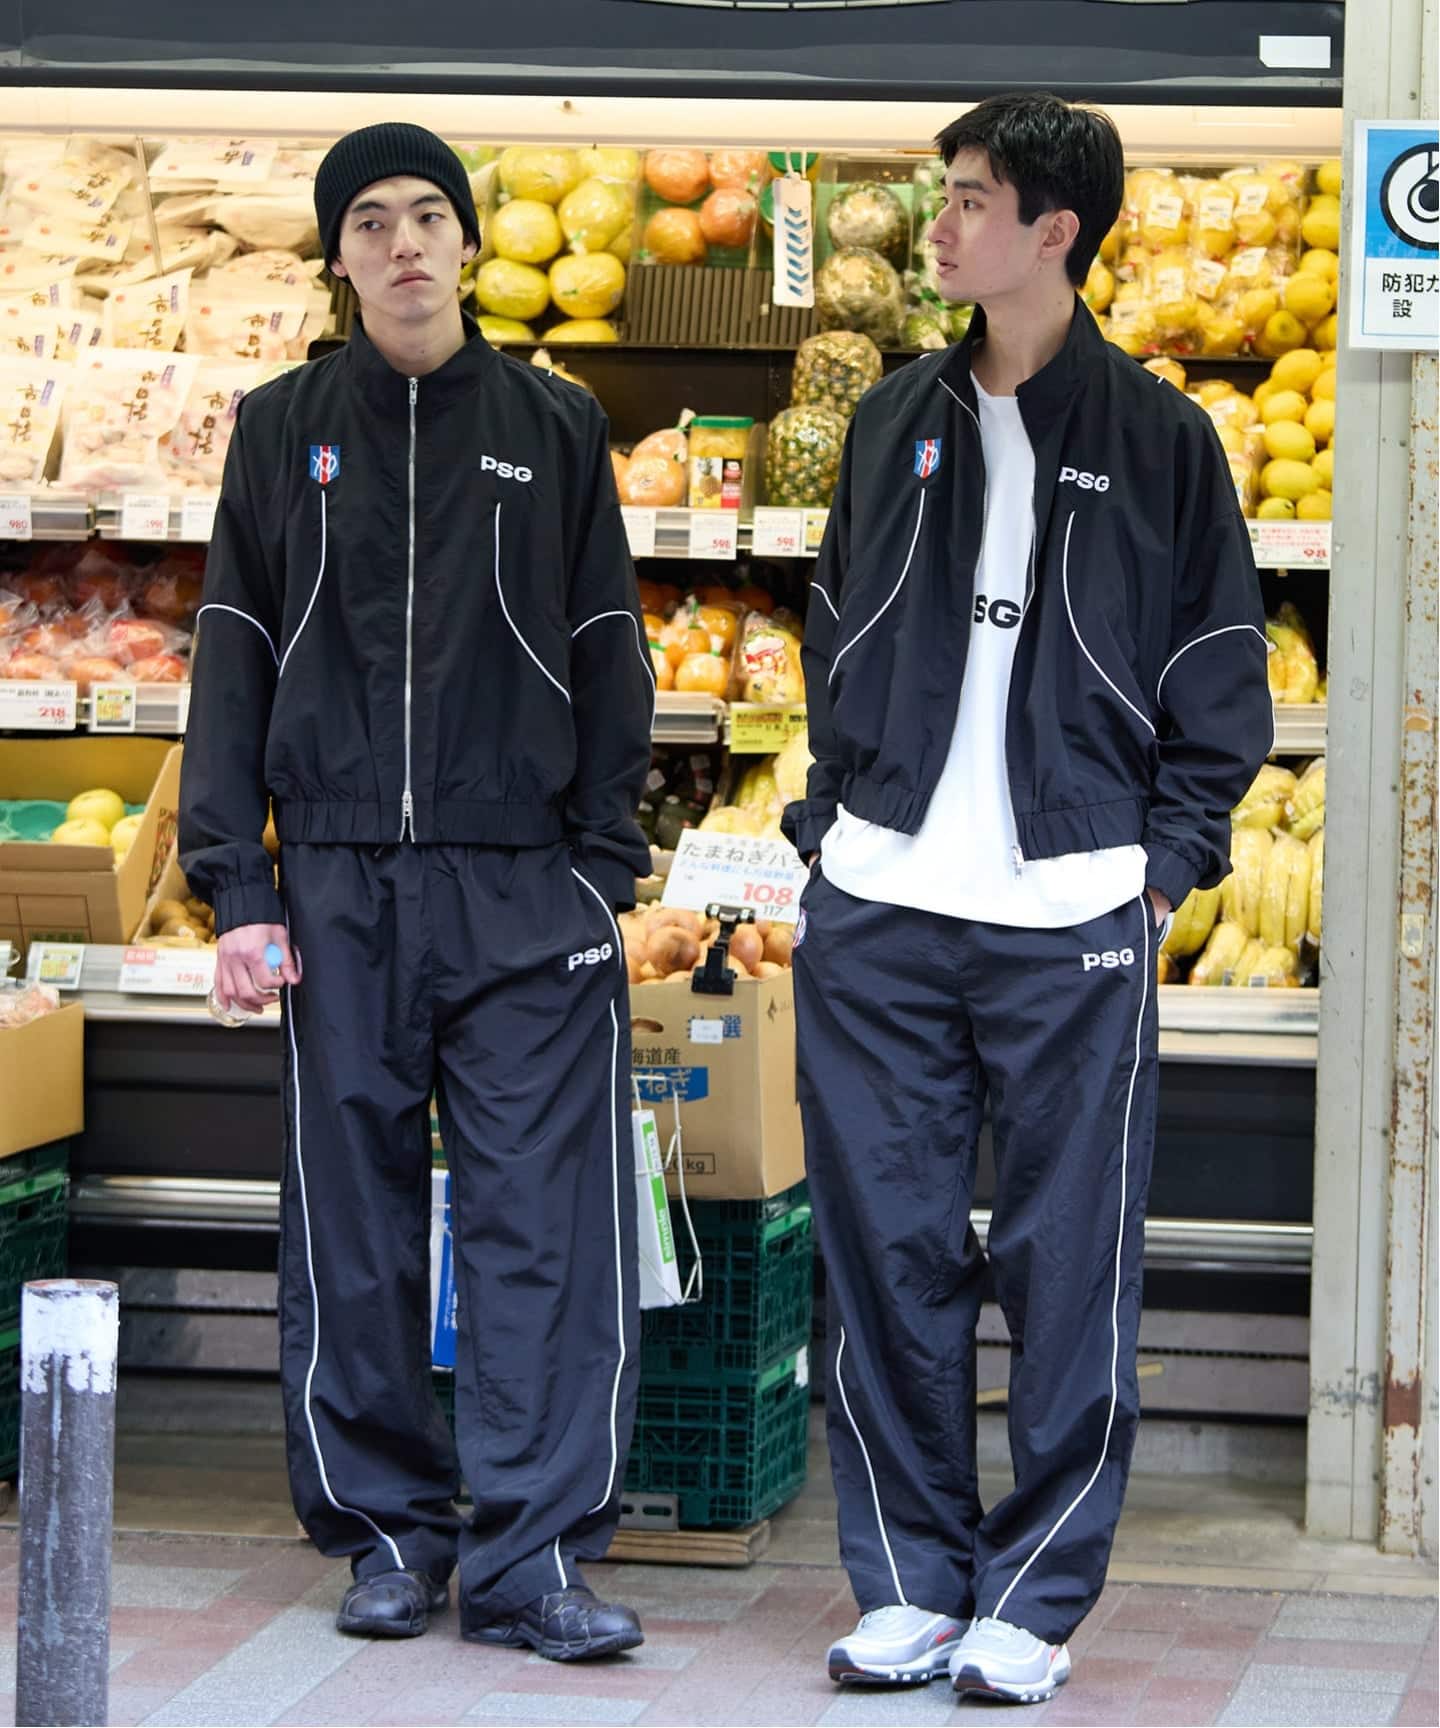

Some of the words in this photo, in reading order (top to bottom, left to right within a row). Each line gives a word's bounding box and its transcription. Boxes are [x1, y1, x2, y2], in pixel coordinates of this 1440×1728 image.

[1392, 299, 1412, 318] 設
[480, 455, 533, 483] PSG
[1059, 466, 1110, 492] PSG
[742, 882, 794, 906] 108
[568, 942, 613, 972] PSG
[1082, 947, 1135, 972] PSG
